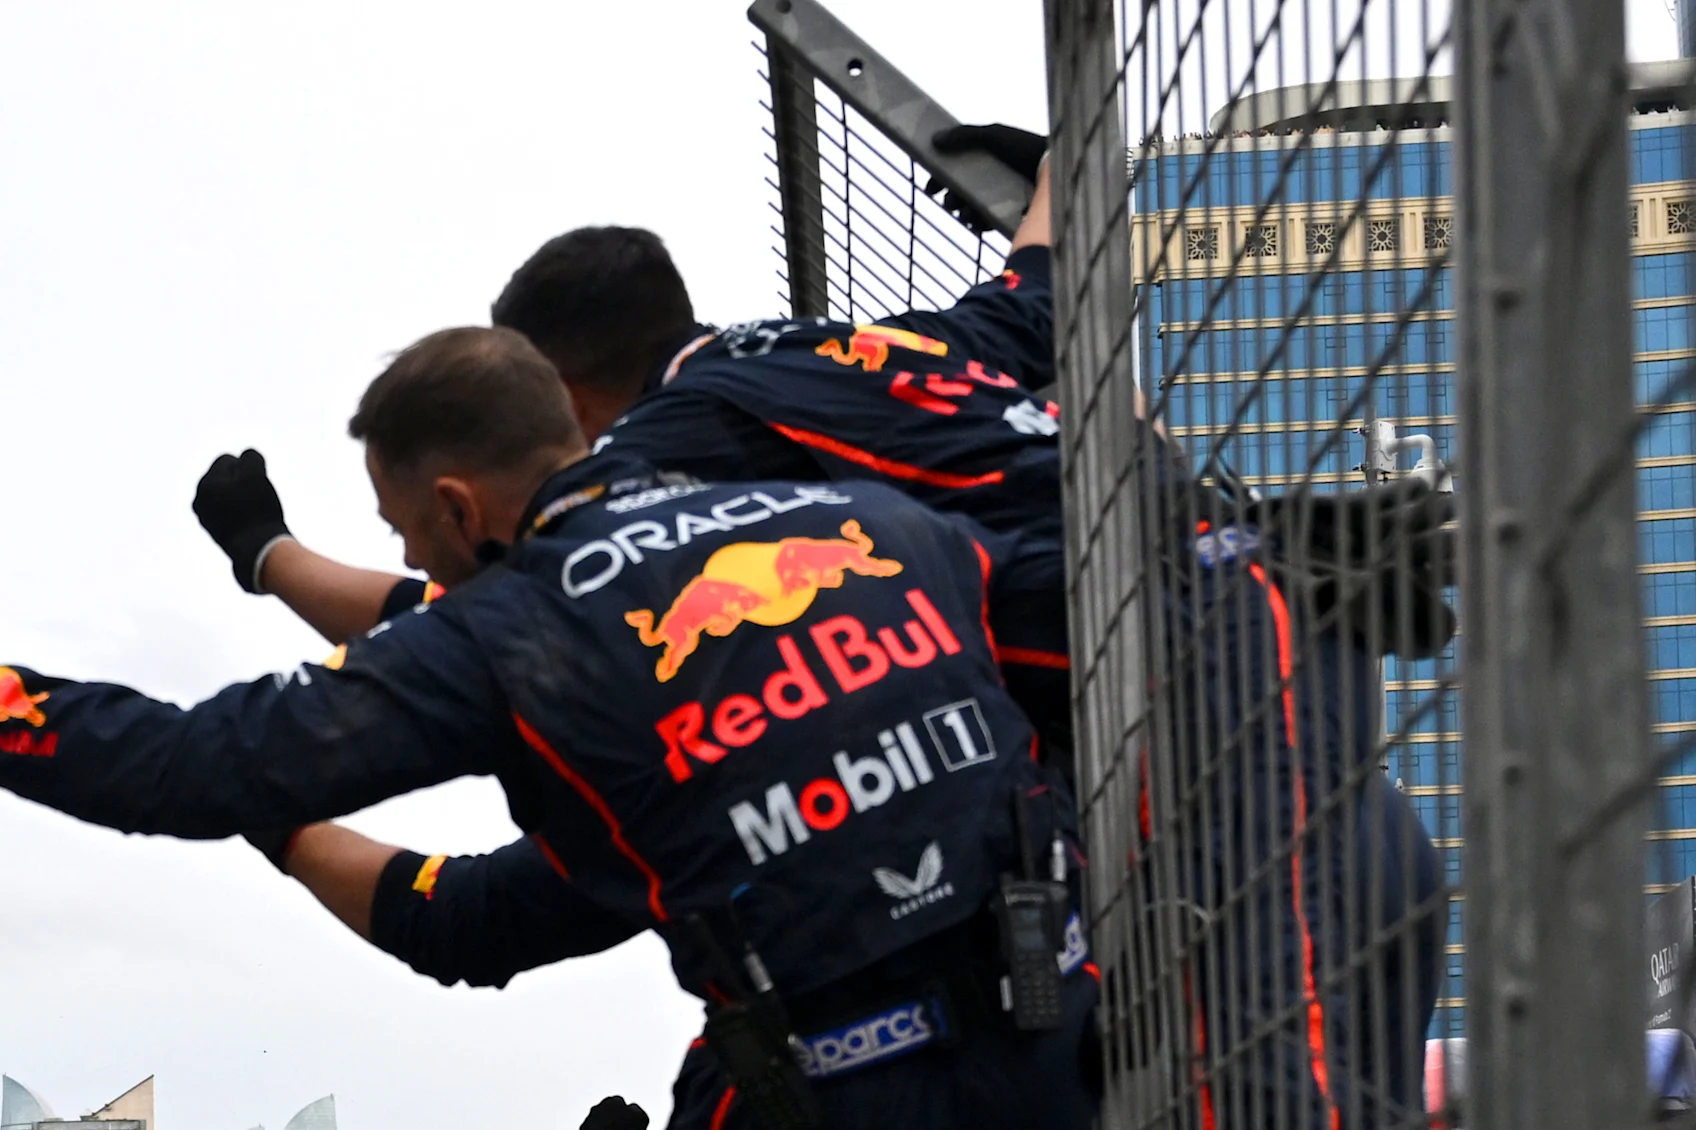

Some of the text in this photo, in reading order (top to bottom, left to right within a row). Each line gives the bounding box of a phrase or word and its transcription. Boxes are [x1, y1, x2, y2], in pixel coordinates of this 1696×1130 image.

[562, 486, 851, 598] ORACLE
[655, 634, 828, 784] Red
[728, 722, 935, 865] Mobil
